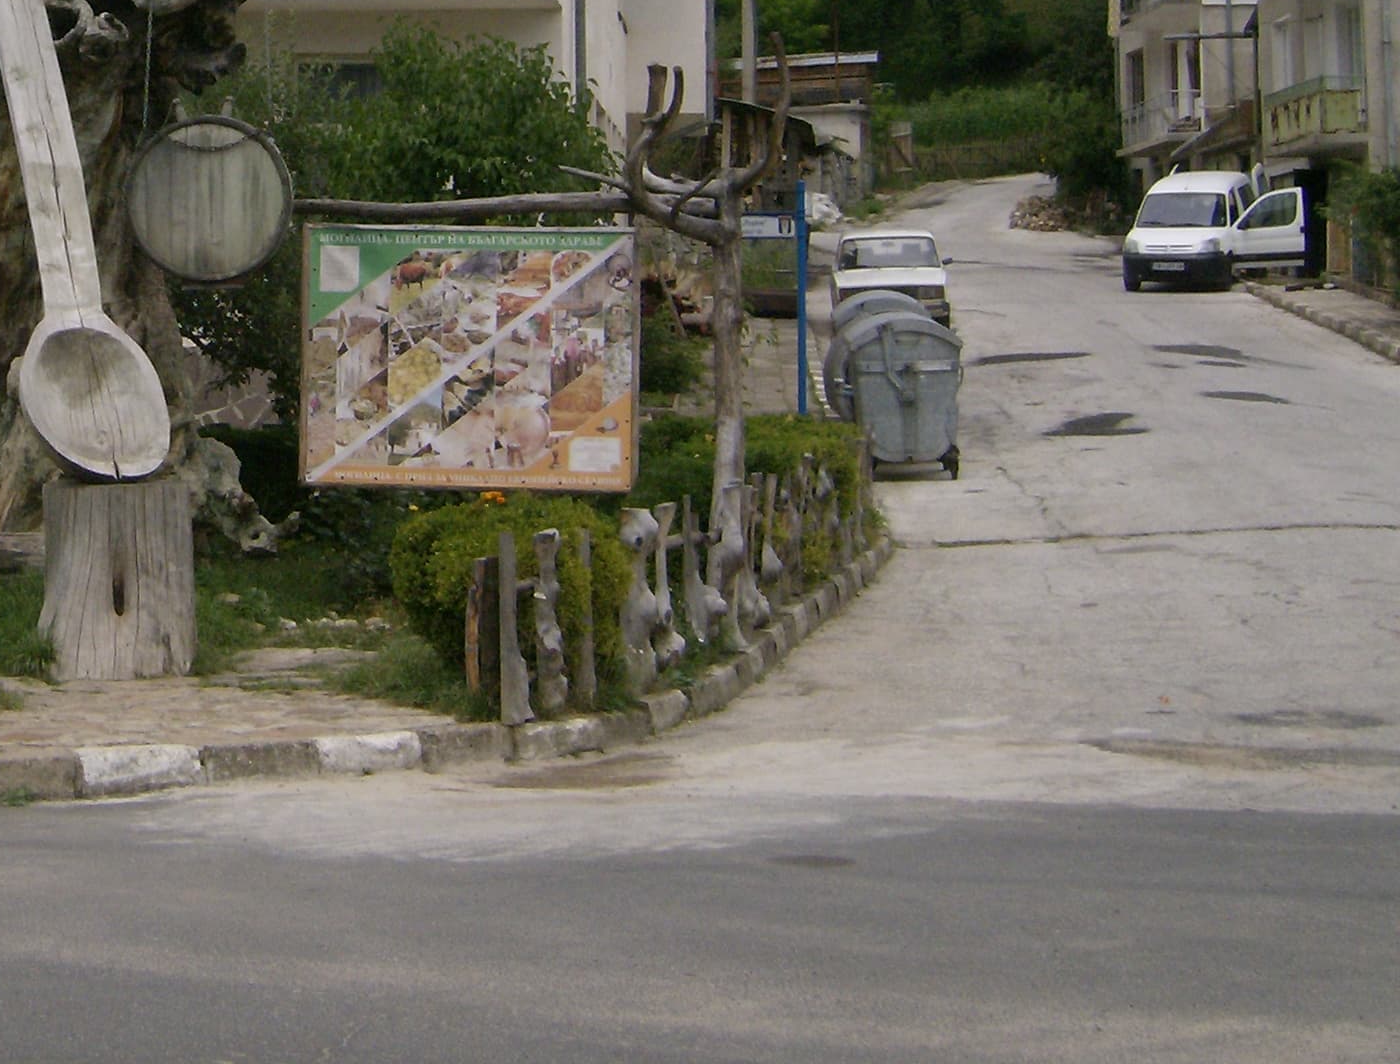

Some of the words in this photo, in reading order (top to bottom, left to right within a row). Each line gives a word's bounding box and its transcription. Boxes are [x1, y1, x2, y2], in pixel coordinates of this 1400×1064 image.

[396, 234, 445, 245] ЦЕНТЪР
[448, 235, 465, 245] НА
[468, 235, 556, 246] БЪЛГАРСКОТО
